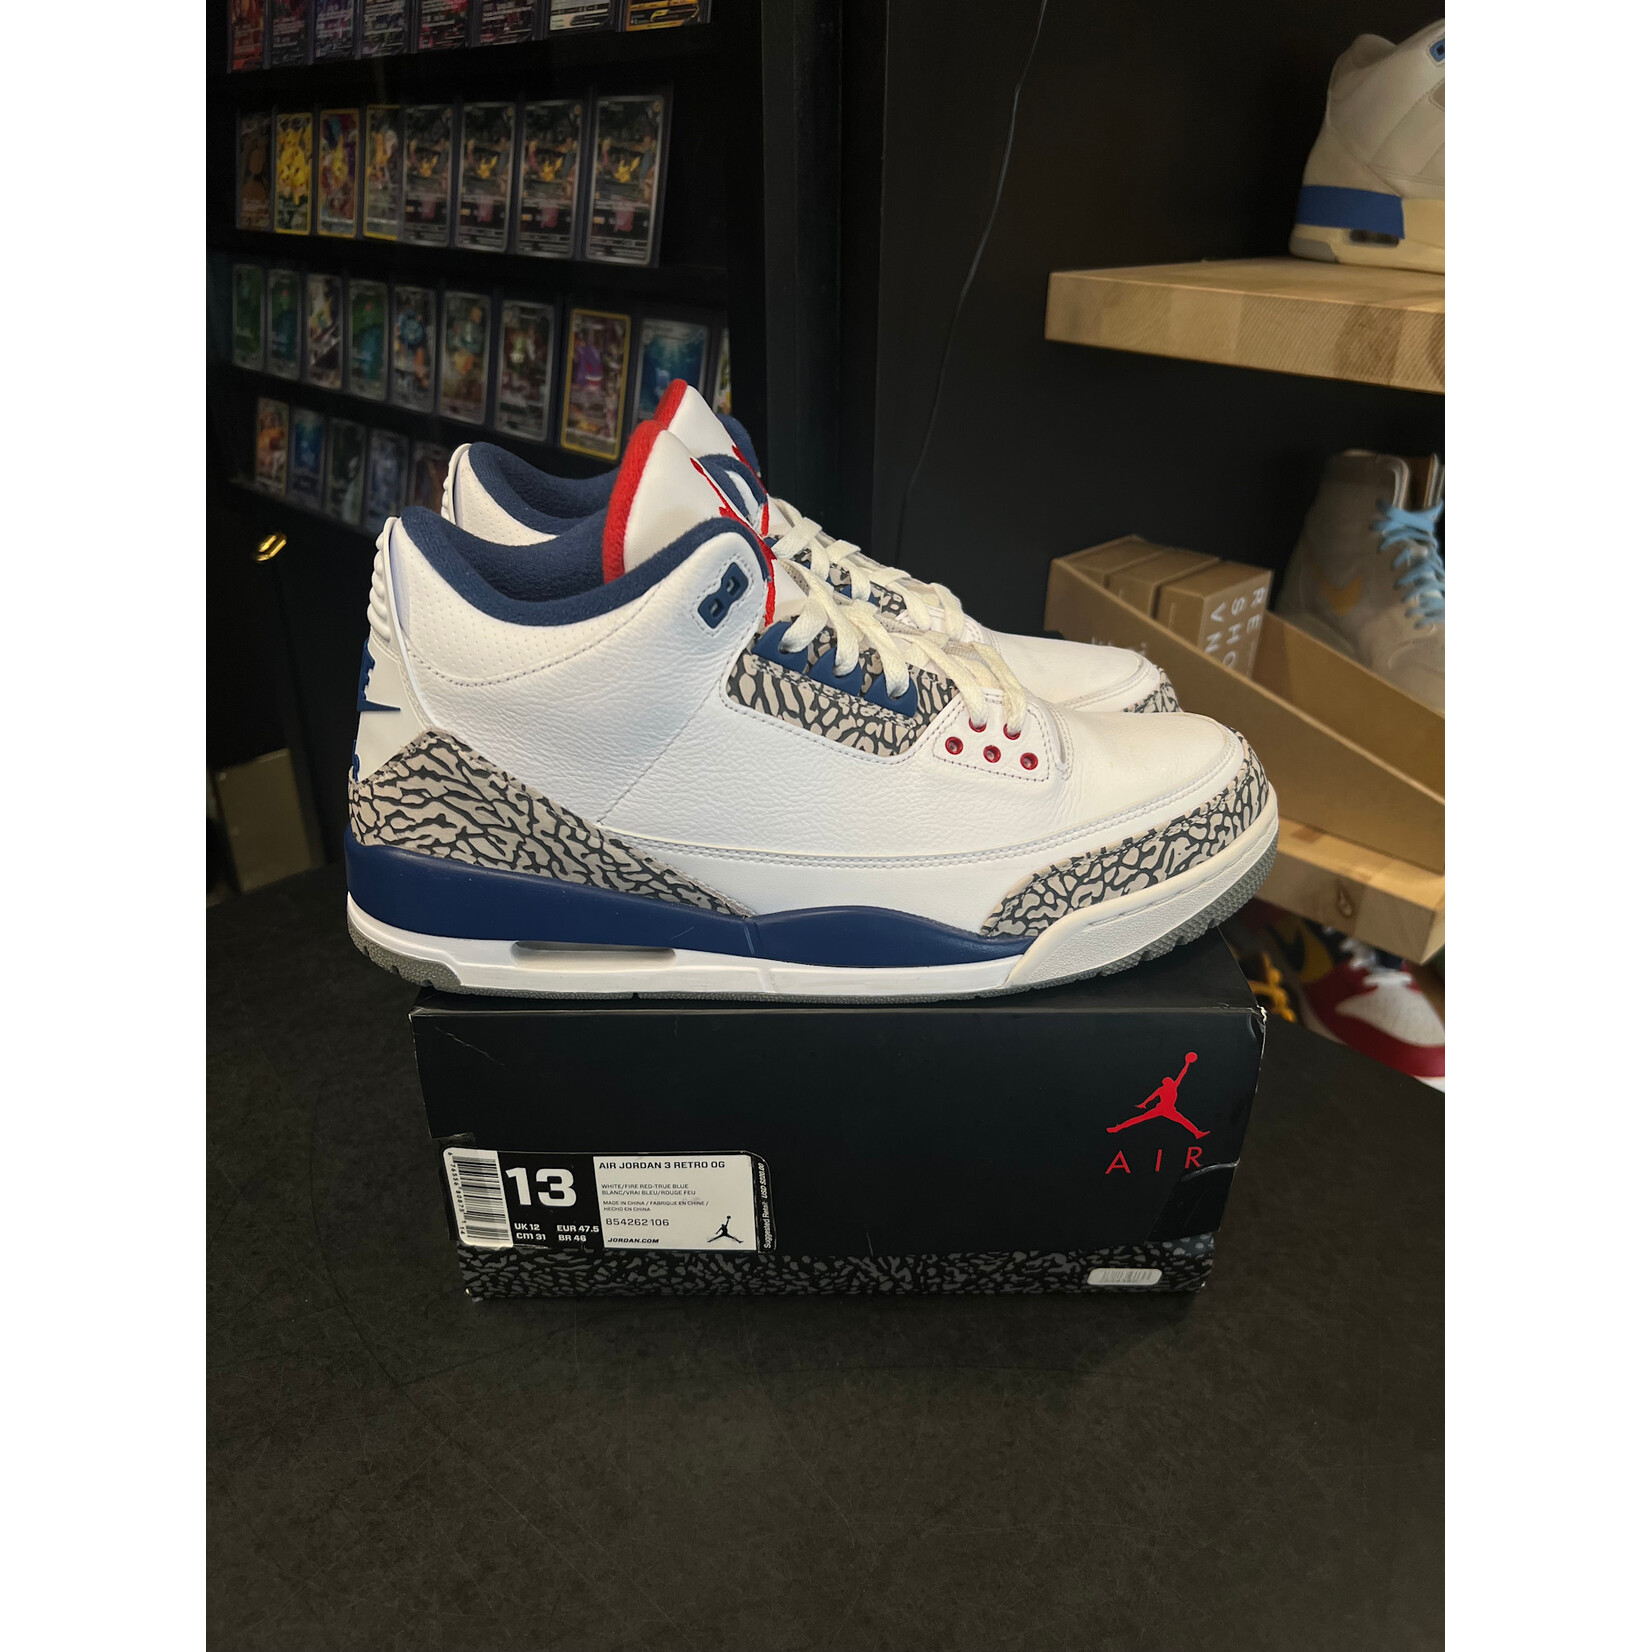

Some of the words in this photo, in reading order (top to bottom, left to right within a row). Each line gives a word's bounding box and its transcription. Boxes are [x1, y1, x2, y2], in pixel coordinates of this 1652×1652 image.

[664, 1161, 671, 1169] 3
[674, 1161, 708, 1169] RETRO
[711, 1161, 725, 1169] OG
[1105, 1147, 1203, 1175] AIR
[505, 1166, 577, 1207] 13
[760, 1185, 768, 1199] USD
[529, 1223, 541, 1231] 12
[578, 1225, 600, 1233] 47.5
[535, 1233, 547, 1241] 31
[763, 1218, 773, 1248] Suggested
[558, 1234, 572, 1242] BR
